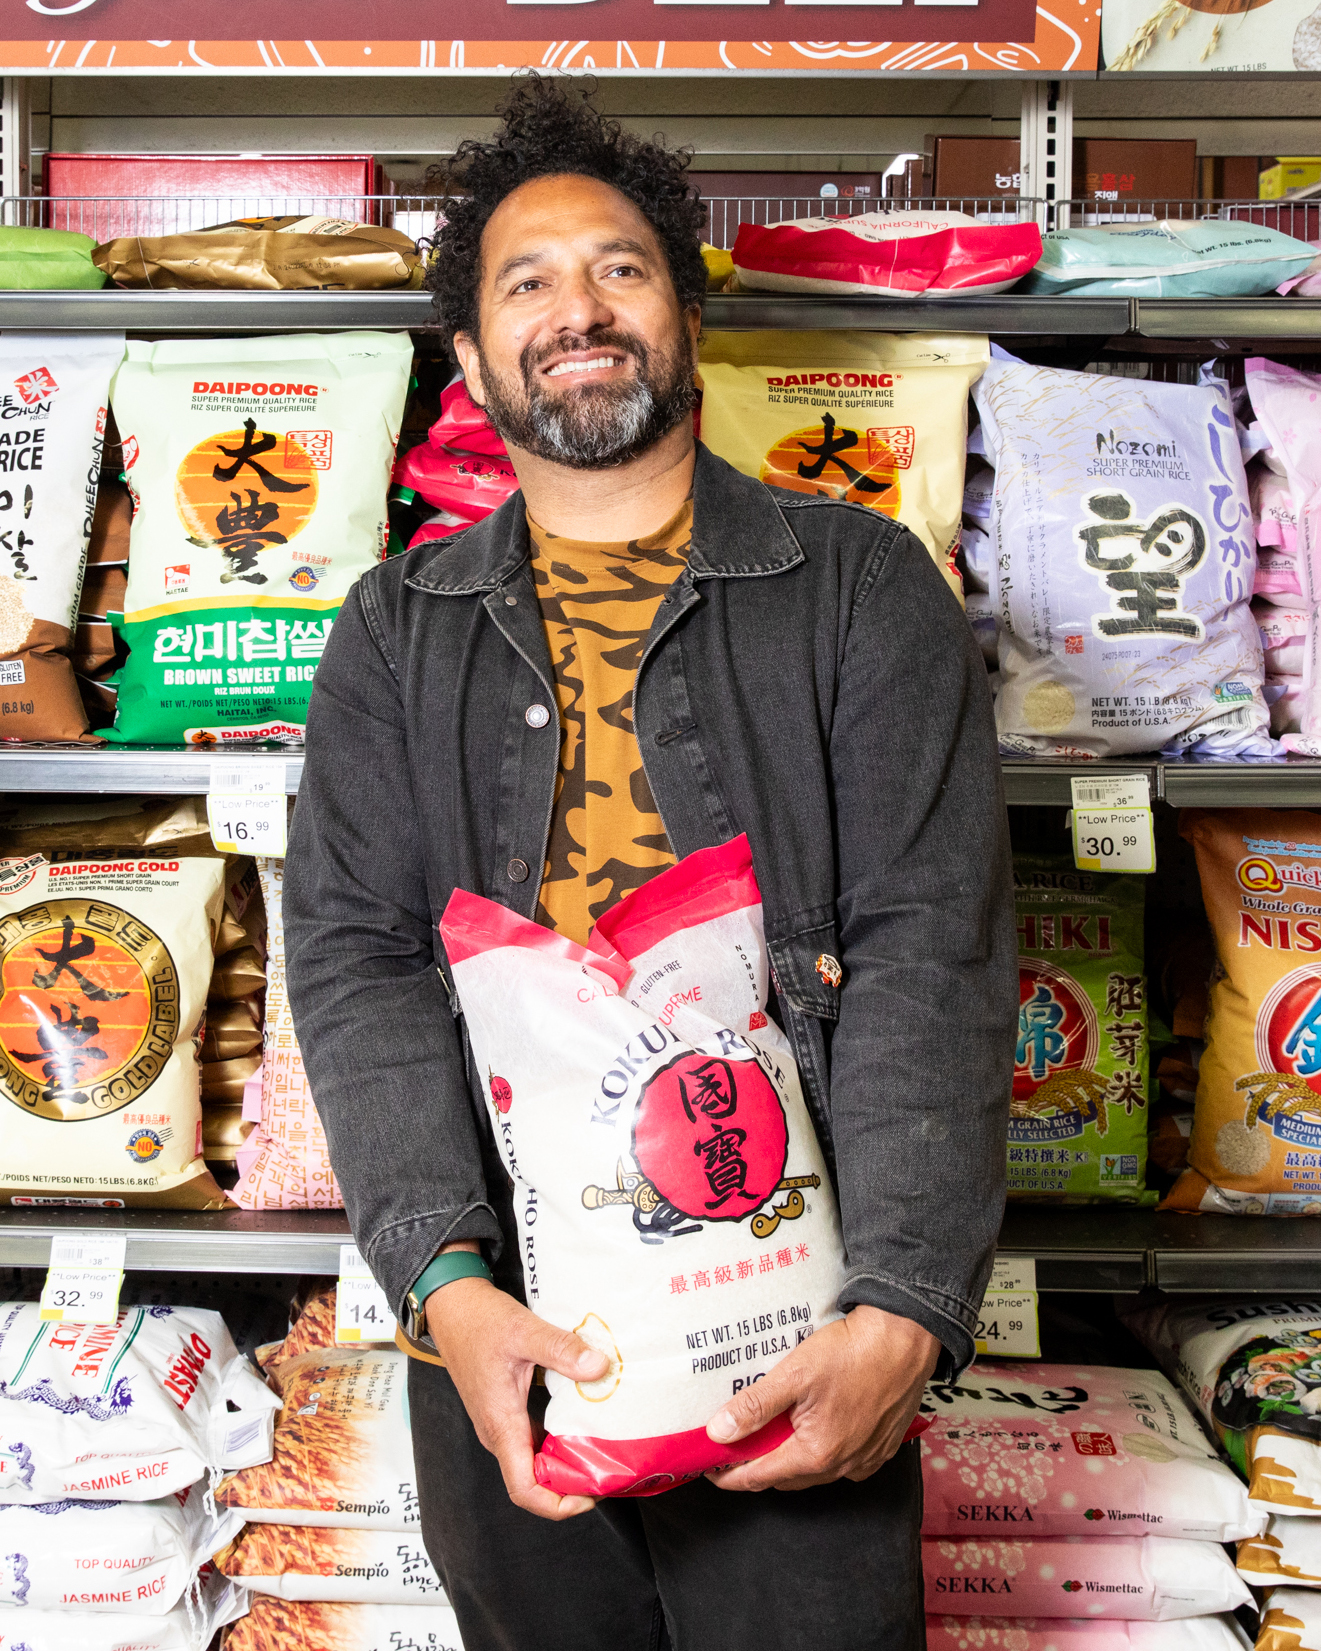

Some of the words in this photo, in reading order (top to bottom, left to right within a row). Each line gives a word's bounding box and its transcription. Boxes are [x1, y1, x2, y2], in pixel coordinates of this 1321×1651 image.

[1253, 63, 1267, 71] LBS
[871, 220, 949, 230] CALIFORNIA
[767, 373, 893, 388] DAIPOONG
[193, 382, 318, 396] DAIPOONG
[768, 386, 795, 394] SUPER
[798, 387, 836, 397] PREMIUM
[838, 390, 872, 398] QUALITY
[784, 396, 809, 405] SUPER
[812, 399, 843, 407] QUALITÉ
[845, 399, 894, 408] SUPÉRIEURE
[1, 402, 50, 419] CHUN
[30, 413, 50, 421] RICE
[797, 411, 893, 495] 大
[1093, 458, 1128, 468] SUPER
[1132, 459, 1184, 471] PREMIUM
[1086, 467, 1126, 477] SHORT
[1129, 468, 1165, 478] GRAIN
[1168, 470, 1191, 481] RICE
[297, 575, 310, 585] NO
[153, 619, 335, 663] 현미찹쌀
[1, 672, 23, 683] FREE
[164, 668, 223, 685] BROWN
[227, 666, 281, 684] SWEET
[286, 665, 318, 682] RIC
[214, 687, 228, 695] RIZ
[229, 687, 251, 695] BRUN
[253, 686, 275, 694] DOUX
[2, 702, 19, 716] (6.8
[20, 700, 34, 715] kg)
[161, 700, 173, 708] NET
[175, 699, 213, 708] WT./POIDS
[216, 698, 250, 707] NET/PESO
[1091, 697, 1111, 707] NET
[1113, 697, 1132, 707] WT.
[1135, 697, 1146, 706] 15
[1149, 697, 1160, 706] LB
[217, 708, 253, 717] HAITAI,
[1091, 710, 1116, 718] 内容量
[1119, 709, 1128, 717] 15
[1129, 709, 1152, 717] ポンド
[1091, 718, 1127, 728] Product
[1129, 718, 1141, 727] of
[1144, 717, 1171, 727] U.S.A.
[220, 725, 301, 740] DAIPOONG
[49, 862, 134, 876] DAIPOONG
[138, 861, 179, 872] GOLD
[1030, 872, 1094, 892] RICE
[1242, 896, 1290, 912] Whole
[640, 959, 682, 995] GLUTEN-FREE
[735, 944, 760, 1001] NOMURA
[577, 985, 614, 1003] CAL
[91, 1058, 159, 1110] GOLD
[148, 966, 177, 1058] LABEL
[1104, 972, 1146, 1116] 胚芽米
[591, 1023, 706, 1128] KOKU
[714, 1028, 786, 1090] ROSE
[123, 1113, 171, 1125] 最高優良品種米
[1024, 1119, 1050, 1130] GRAIN
[1053, 1115, 1076, 1127] RICE
[1027, 1127, 1076, 1140] SELECTED
[138, 1142, 152, 1152] NO
[33, 1175, 71, 1183] NET/PESO
[1010, 1168, 1019, 1176] 15
[1021, 1168, 1039, 1177] LBS.
[1041, 1168, 1056, 1178] (6.8
[1058, 1169, 1072, 1179] Kg)
[1284, 1171, 1299, 1179] NET
[1302, 1171, 1316, 1179] WT.
[1028, 1181, 1039, 1189] OF
[1041, 1181, 1066, 1190] U.S.A.
[501, 1121, 538, 1227] KOKHO
[525, 1235, 540, 1300] ROSE
[668, 1243, 811, 1295] 最高級新品種米
[686, 1330, 709, 1350] NET
[712, 1324, 734, 1345] WT.
[736, 1320, 750, 1338] 15
[753, 1313, 773, 1333] LBS
[777, 1302, 811, 1327] (6.8kg)
[692, 1347, 742, 1374] PRODUCT
[745, 1343, 758, 1361] OF
[761, 1335, 791, 1356] U.S.A.
[62, 1470, 132, 1492] JASMINE
[136, 1461, 169, 1480] RICE
[335, 1499, 390, 1517] Sempio
[957, 1505, 1034, 1522] SEKKA
[1107, 1509, 1163, 1524] Wismettac
[74, 1558, 100, 1569] TOP
[103, 1555, 156, 1569] QUALITY
[335, 1562, 389, 1580] Sempio
[59, 1591, 133, 1604] JASMINE
[137, 1575, 167, 1600] RICE
[935, 1577, 1012, 1594] SEKKA
[1086, 1581, 1143, 1594] Wismettac
